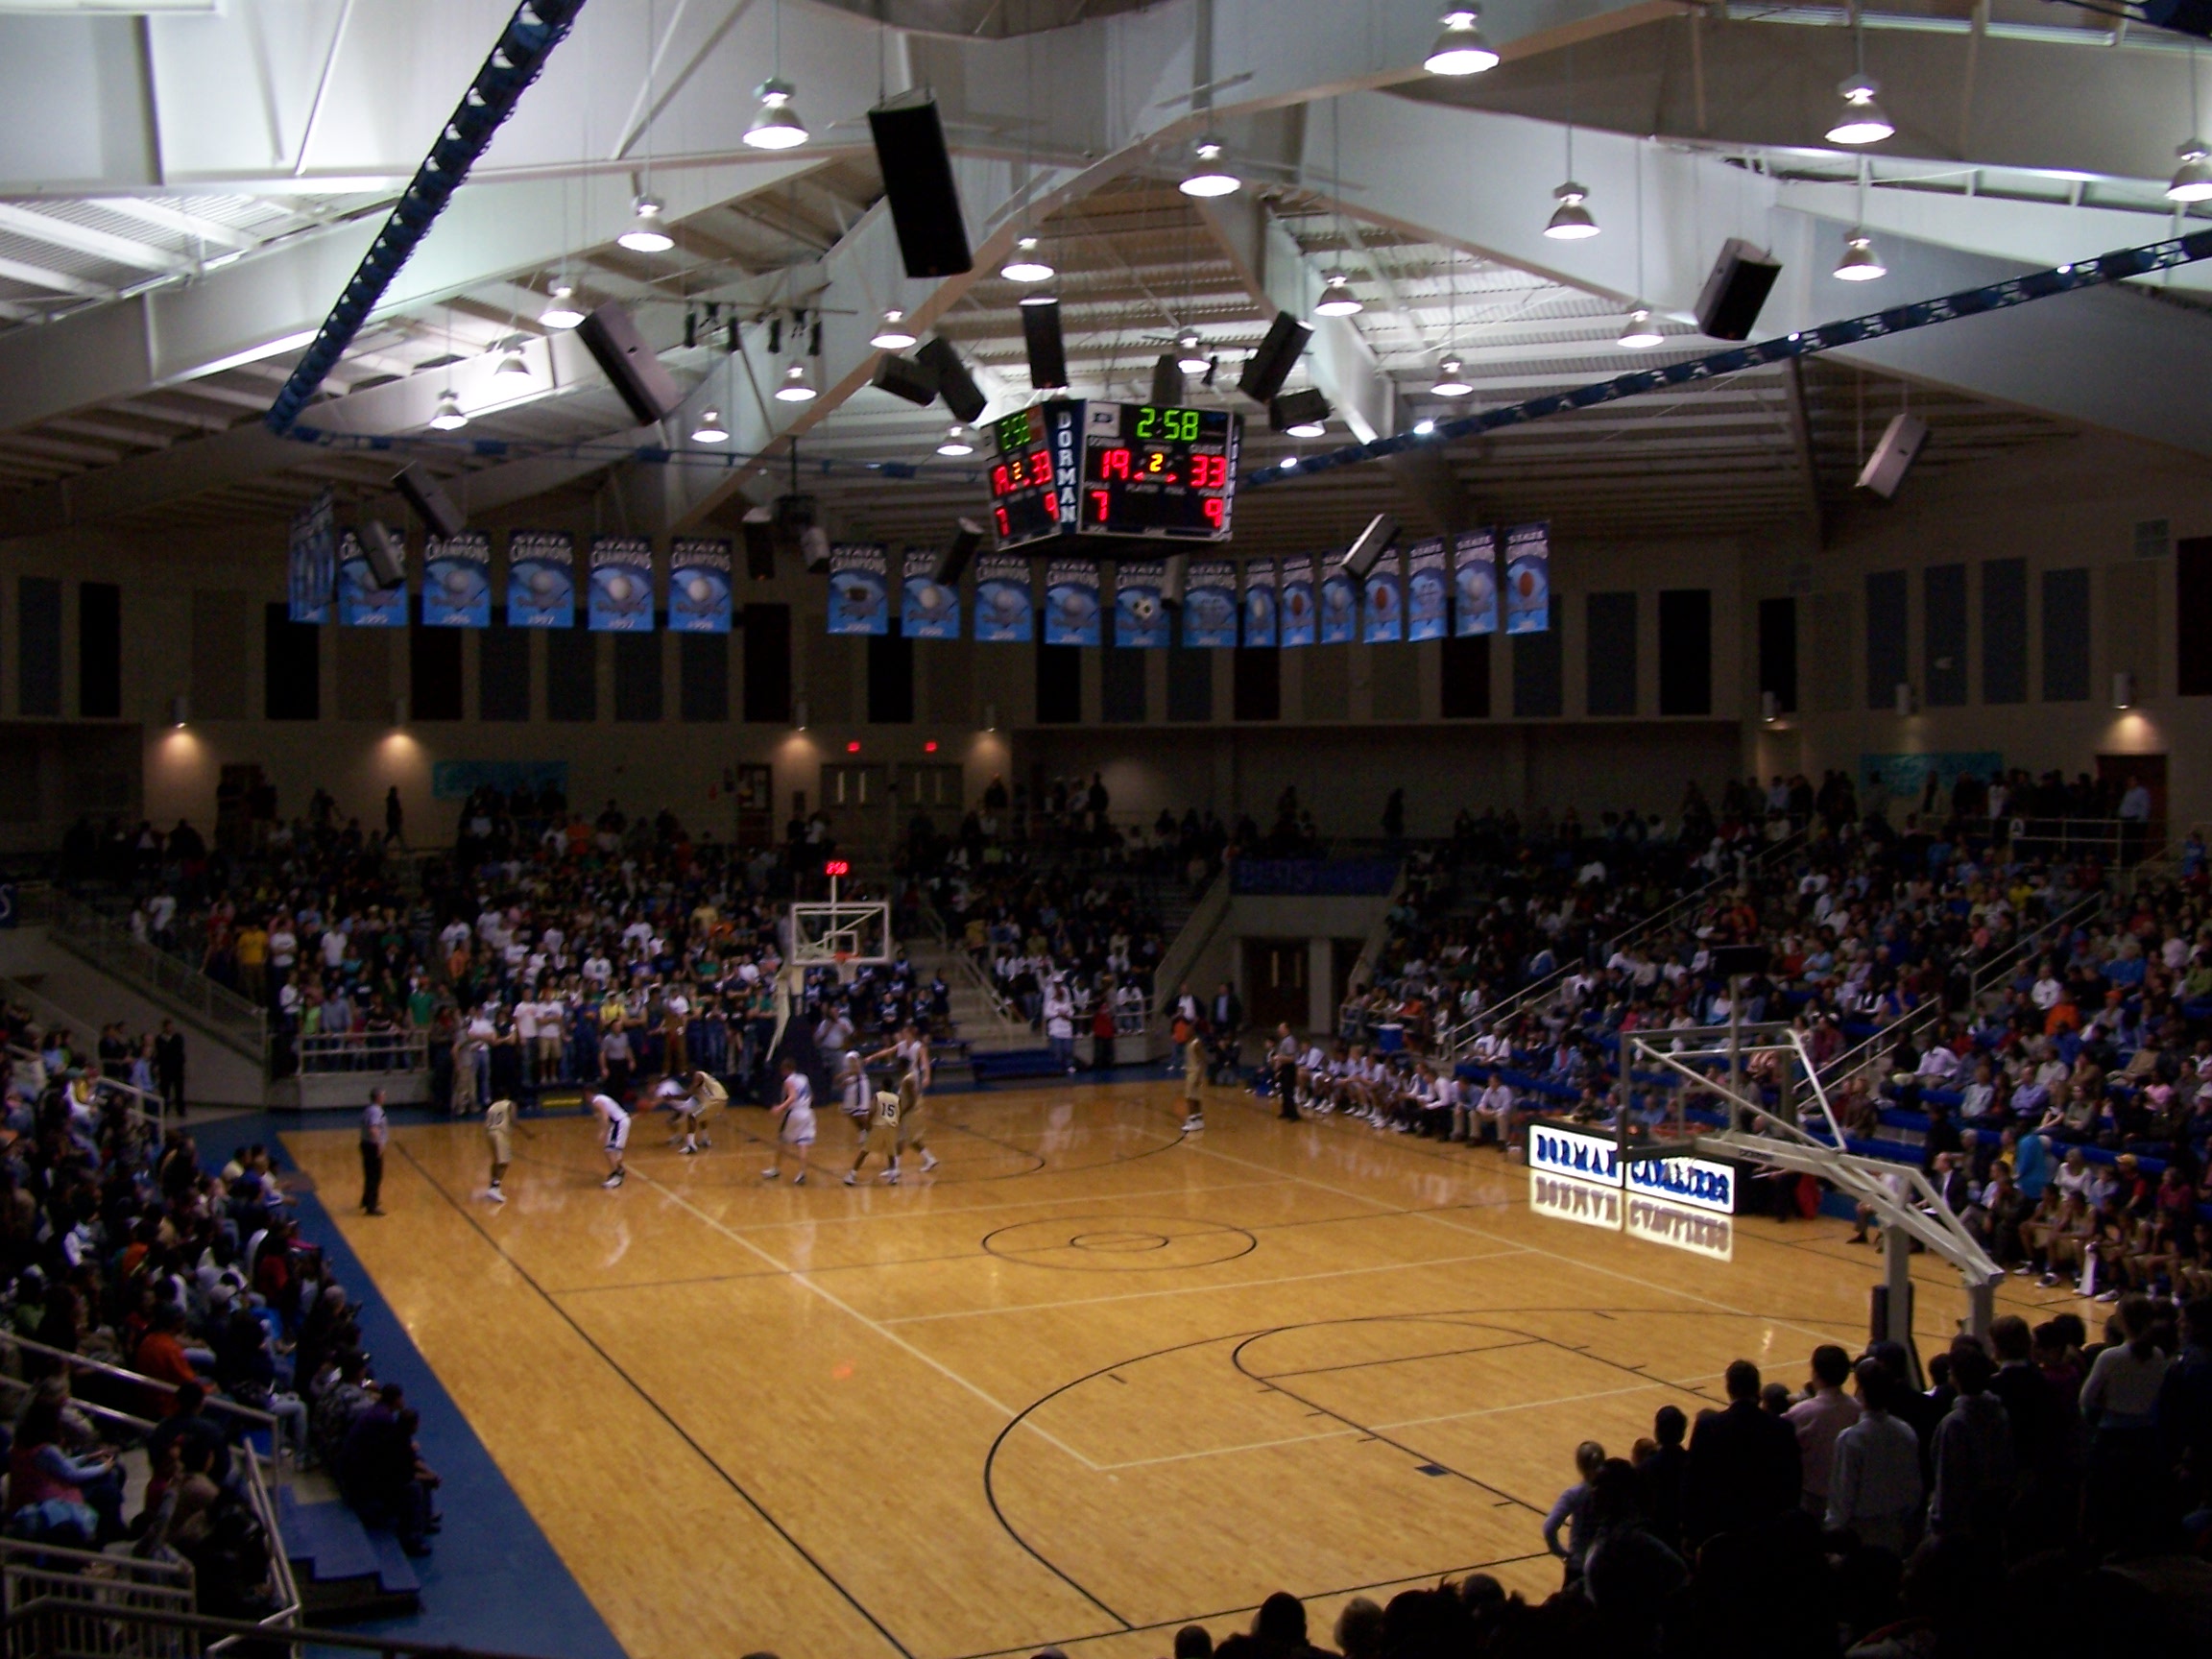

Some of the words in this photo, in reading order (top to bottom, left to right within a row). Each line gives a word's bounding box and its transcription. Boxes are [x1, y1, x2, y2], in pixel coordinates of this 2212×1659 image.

[1137, 407, 1199, 442] 2:58
[1057, 411, 1076, 523] DORMAN
[1101, 449, 1131, 480] 19
[1149, 452, 1165, 473] 2
[1190, 454, 1227, 488] 33
[1091, 490, 1109, 522] 7
[1203, 497, 1224, 529] 9
[881, 1103, 895, 1117] 15
